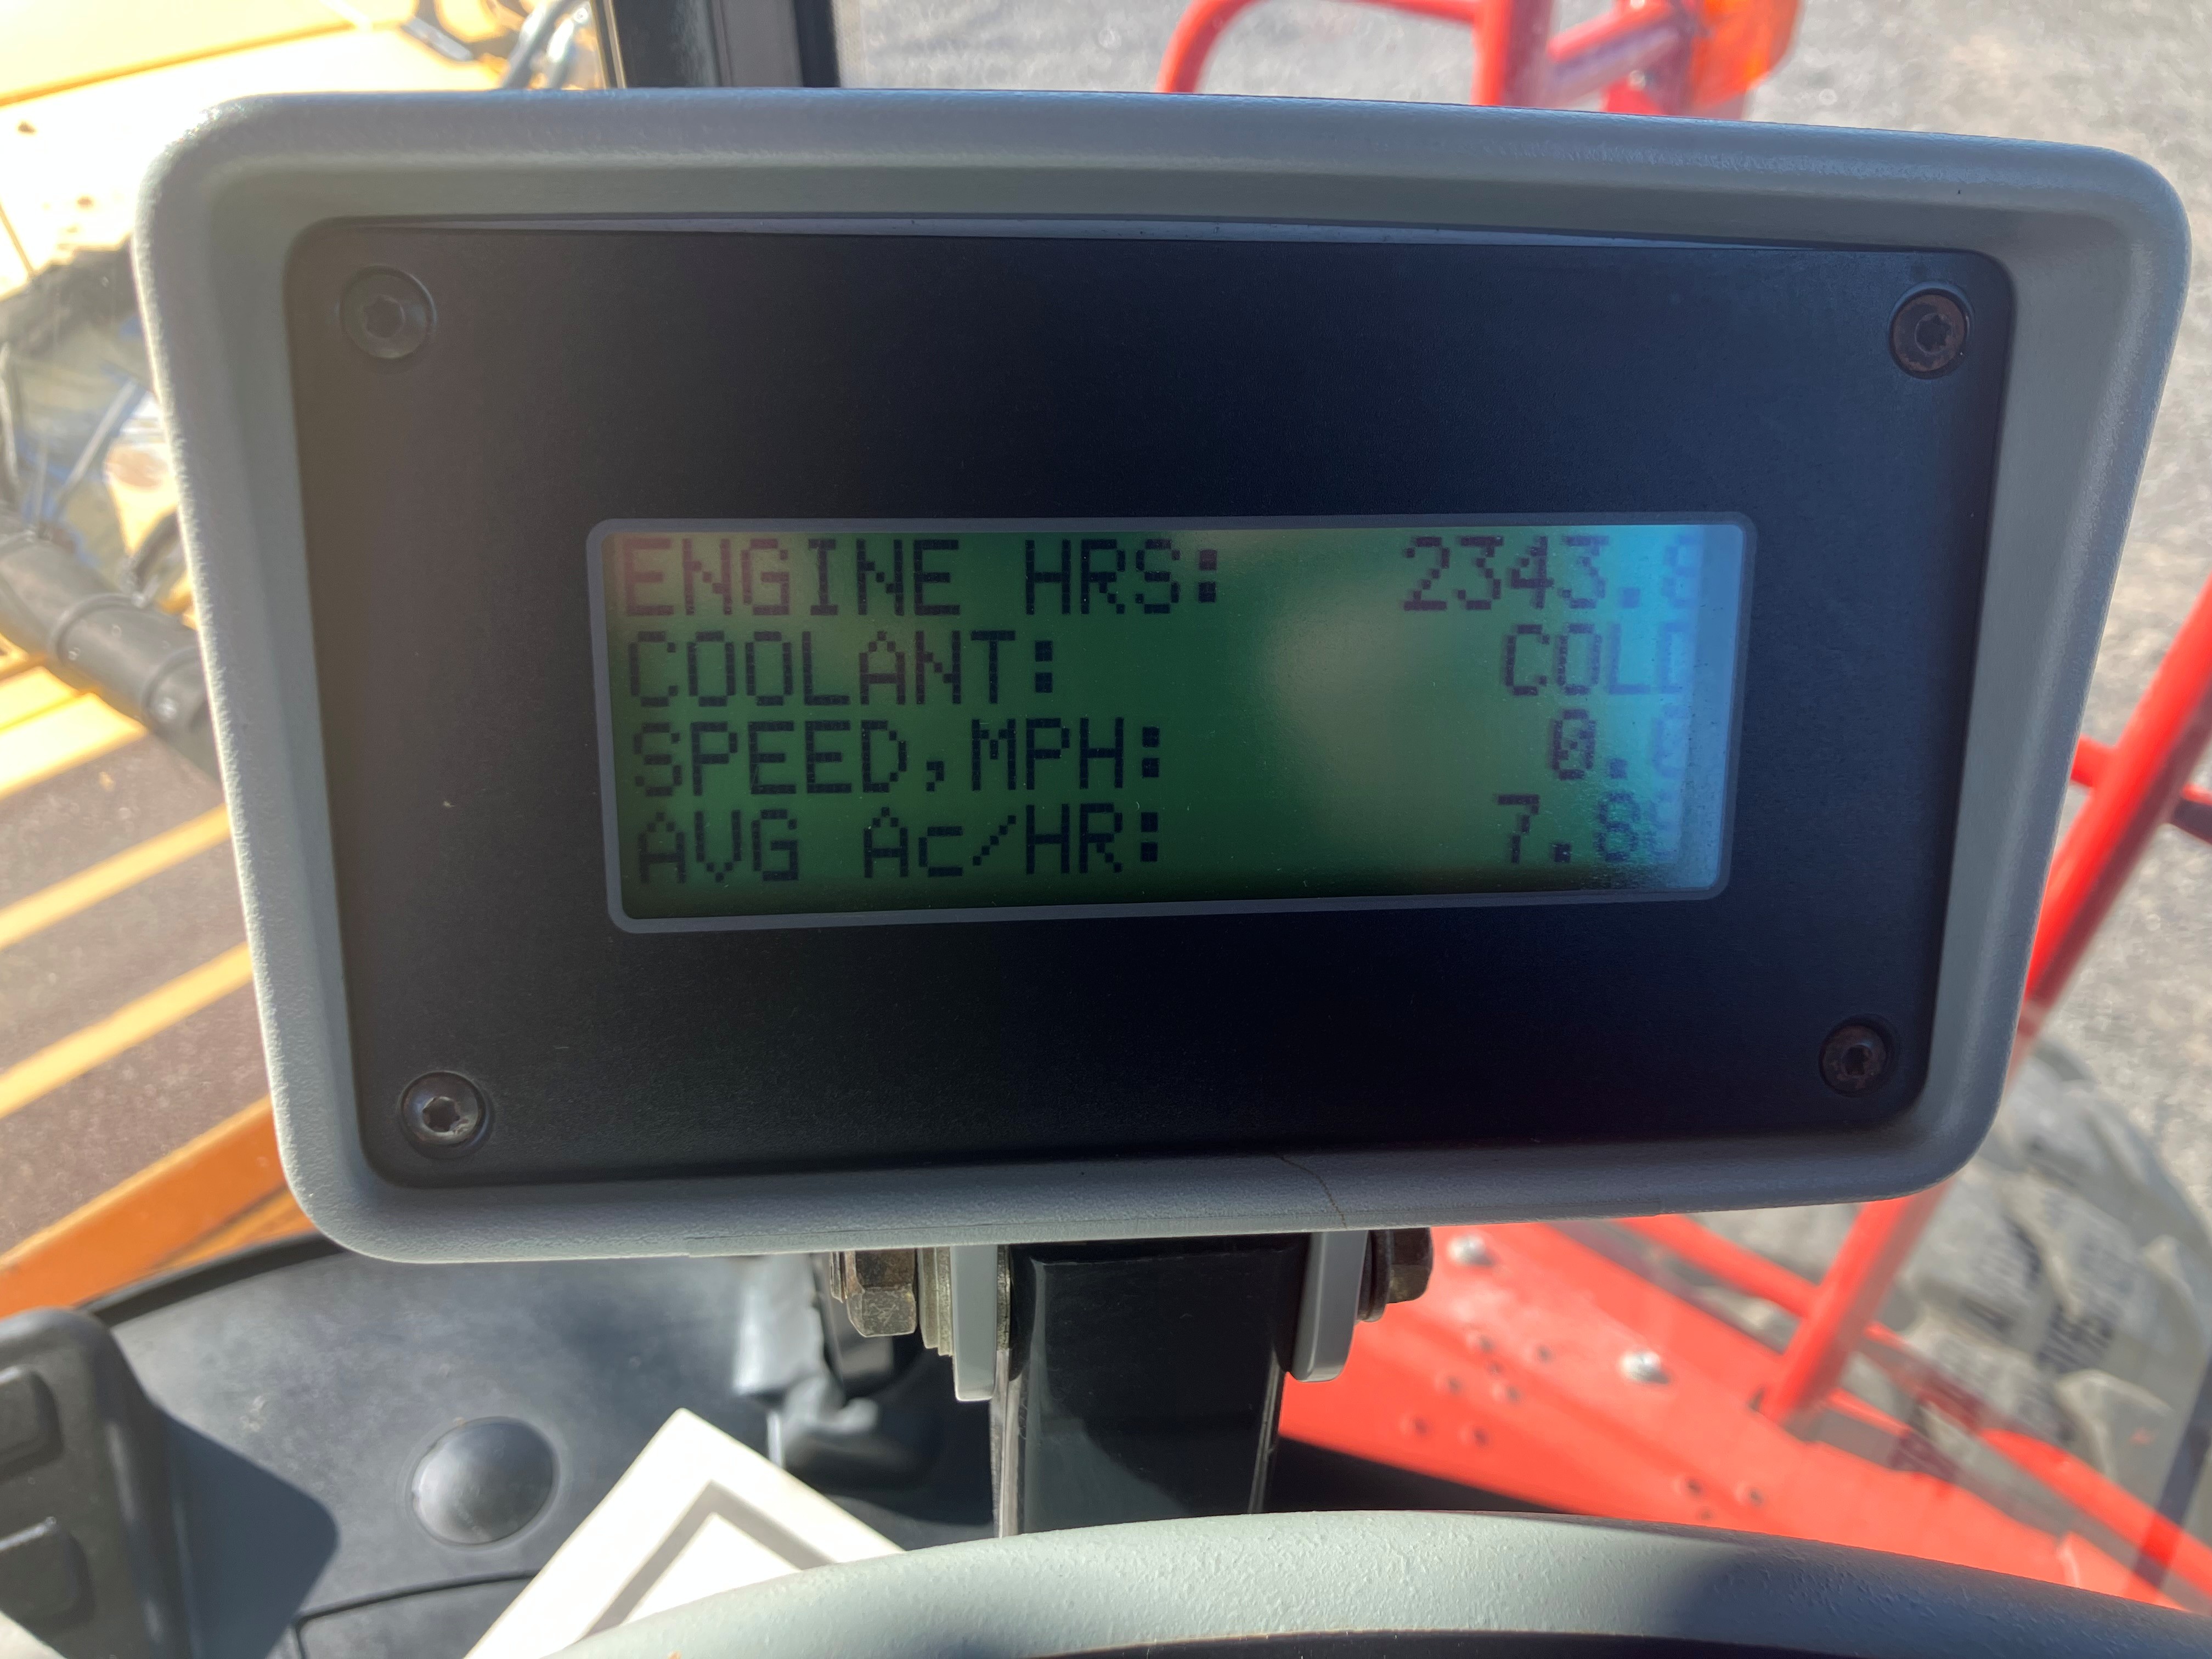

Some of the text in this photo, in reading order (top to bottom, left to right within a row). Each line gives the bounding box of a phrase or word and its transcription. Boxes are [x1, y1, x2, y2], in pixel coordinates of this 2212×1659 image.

[623, 538, 961, 616] ENGINE
[1025, 539, 1218, 614] HRS:
[629, 630, 1053, 706] COOLANT:
[637, 809, 799, 883] AVG
